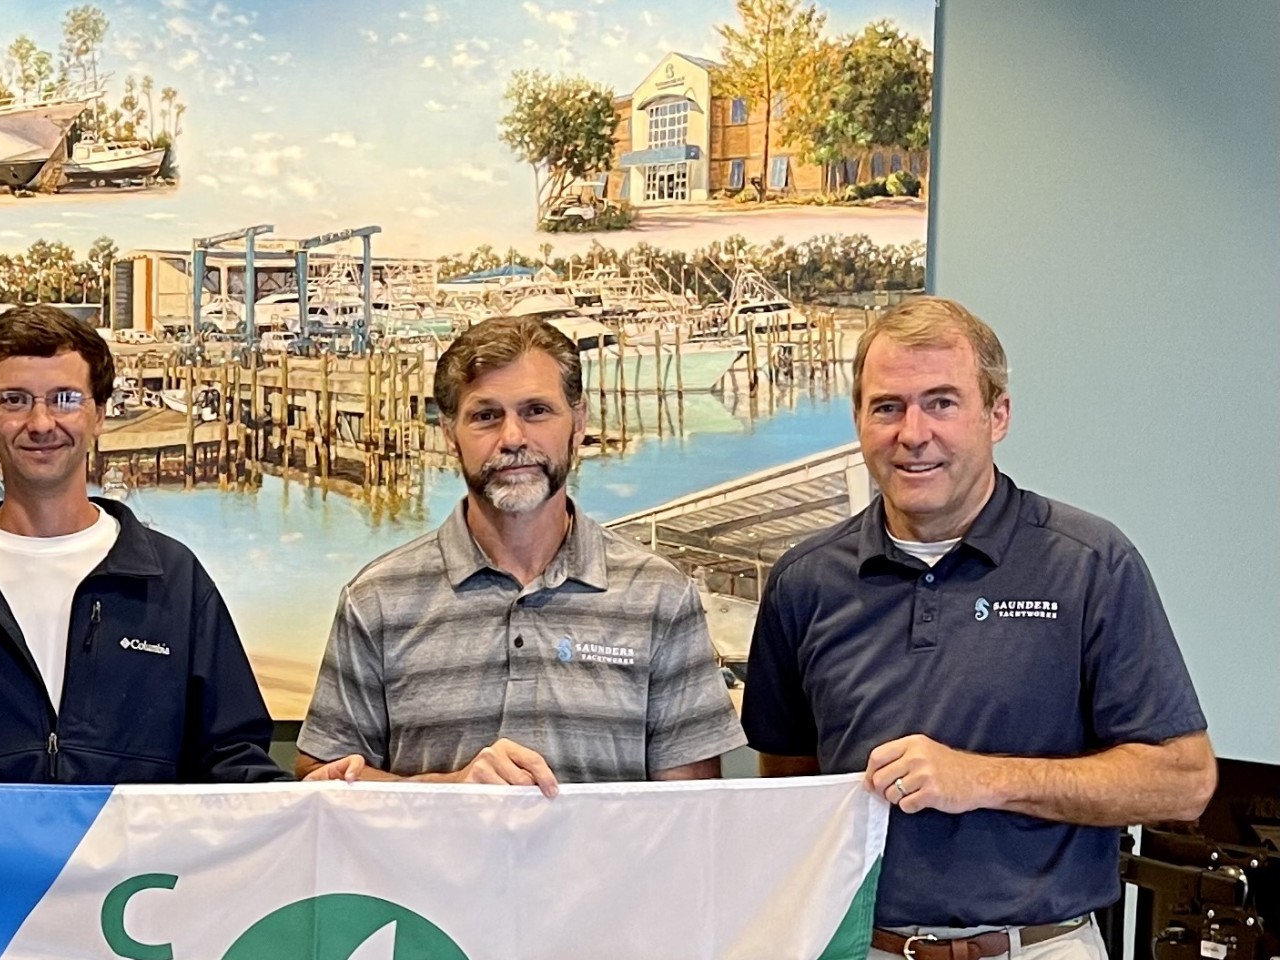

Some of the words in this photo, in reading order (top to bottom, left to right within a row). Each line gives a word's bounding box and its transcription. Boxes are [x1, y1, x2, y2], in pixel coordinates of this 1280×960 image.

[992, 600, 1058, 611] SAUNDERS
[130, 639, 170, 655] Columbia
[575, 643, 635, 656] SAUNDERS
